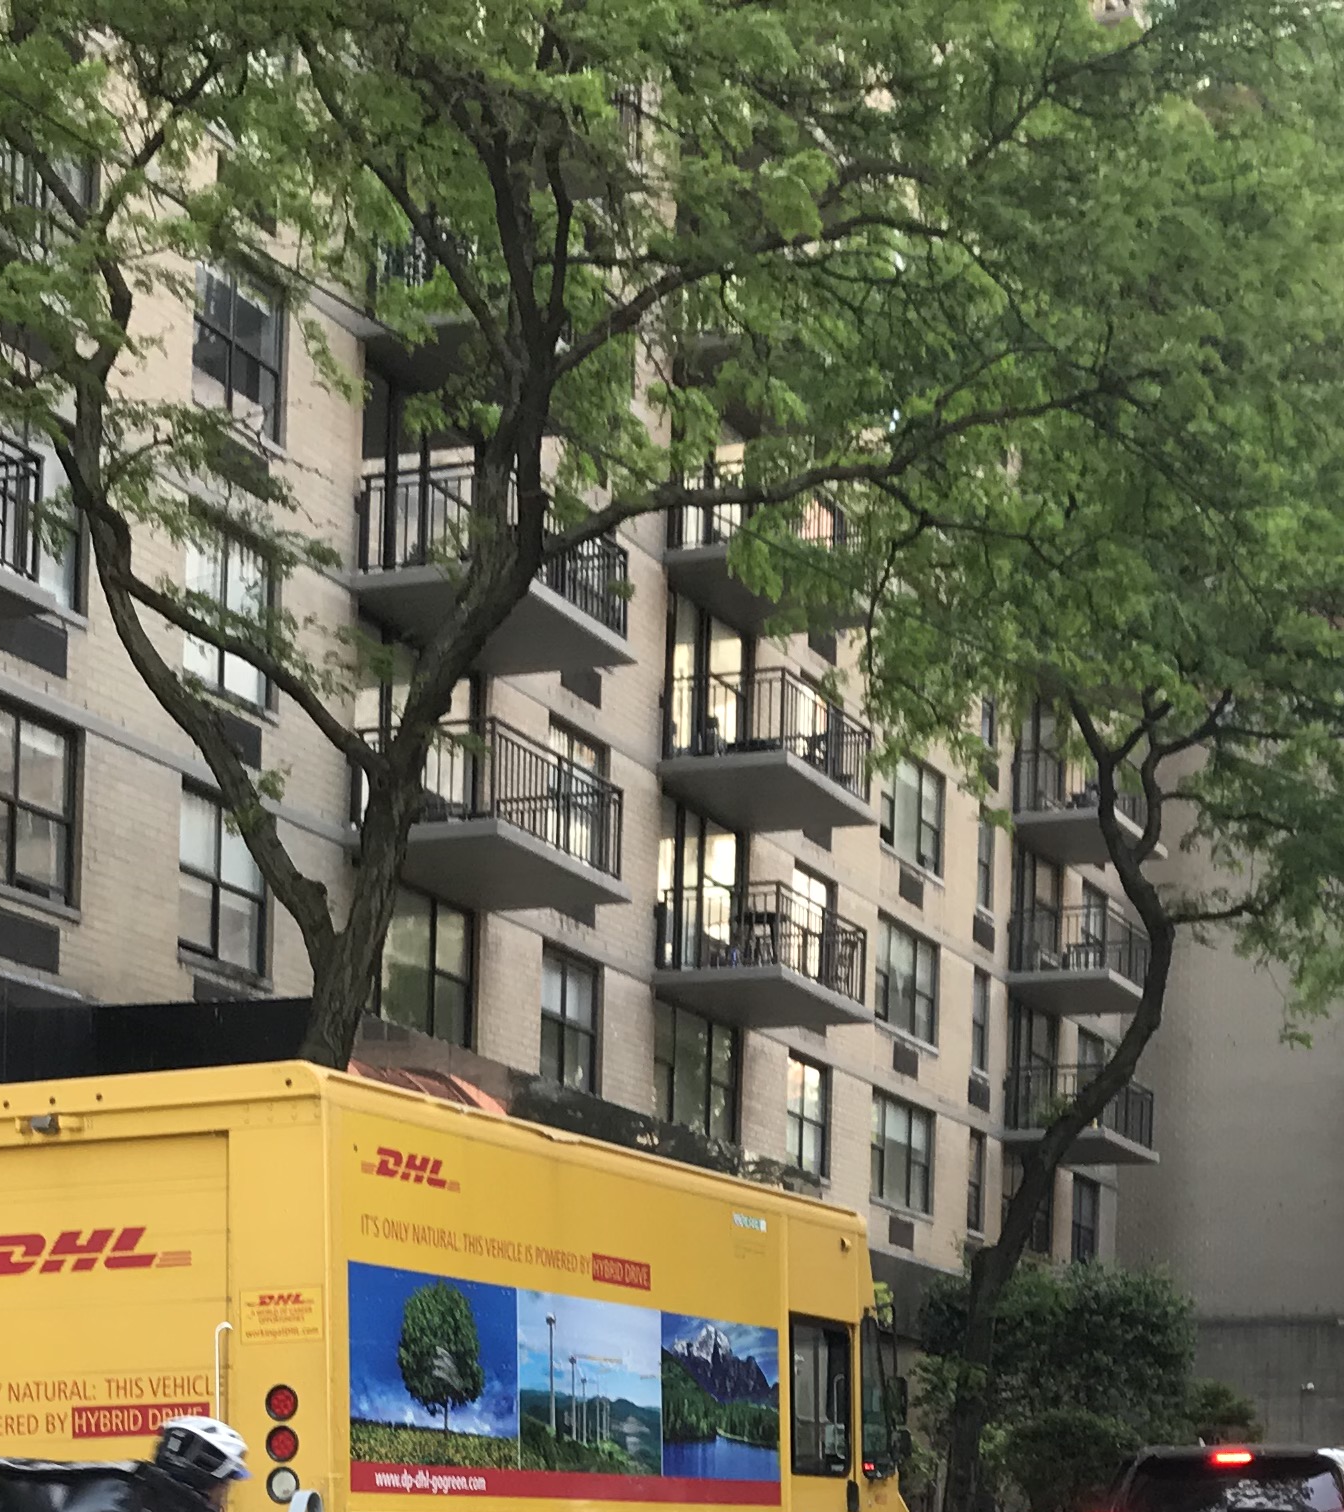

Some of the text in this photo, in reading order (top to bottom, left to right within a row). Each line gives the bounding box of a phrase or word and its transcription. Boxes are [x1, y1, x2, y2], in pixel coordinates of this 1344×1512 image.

[376, 1146, 448, 1190] DHL
[360, 1213, 380, 1239] IT'S
[382, 1216, 410, 1244] ONLY
[463, 1232, 485, 1257] THIS
[485, 1237, 523, 1265] VEHICLE
[524, 1243, 534, 1265] IS
[535, 1245, 578, 1274] POWERED
[579, 1253, 591, 1276] BY
[593, 1258, 624, 1282] HYBRID
[258, 1292, 305, 1307] DHL
[7, 1378, 97, 1404] NATURAL:
[105, 1376, 145, 1400] THIS
[45, 1412, 68, 1434] BY
[74, 1408, 143, 1433] HYBRID
